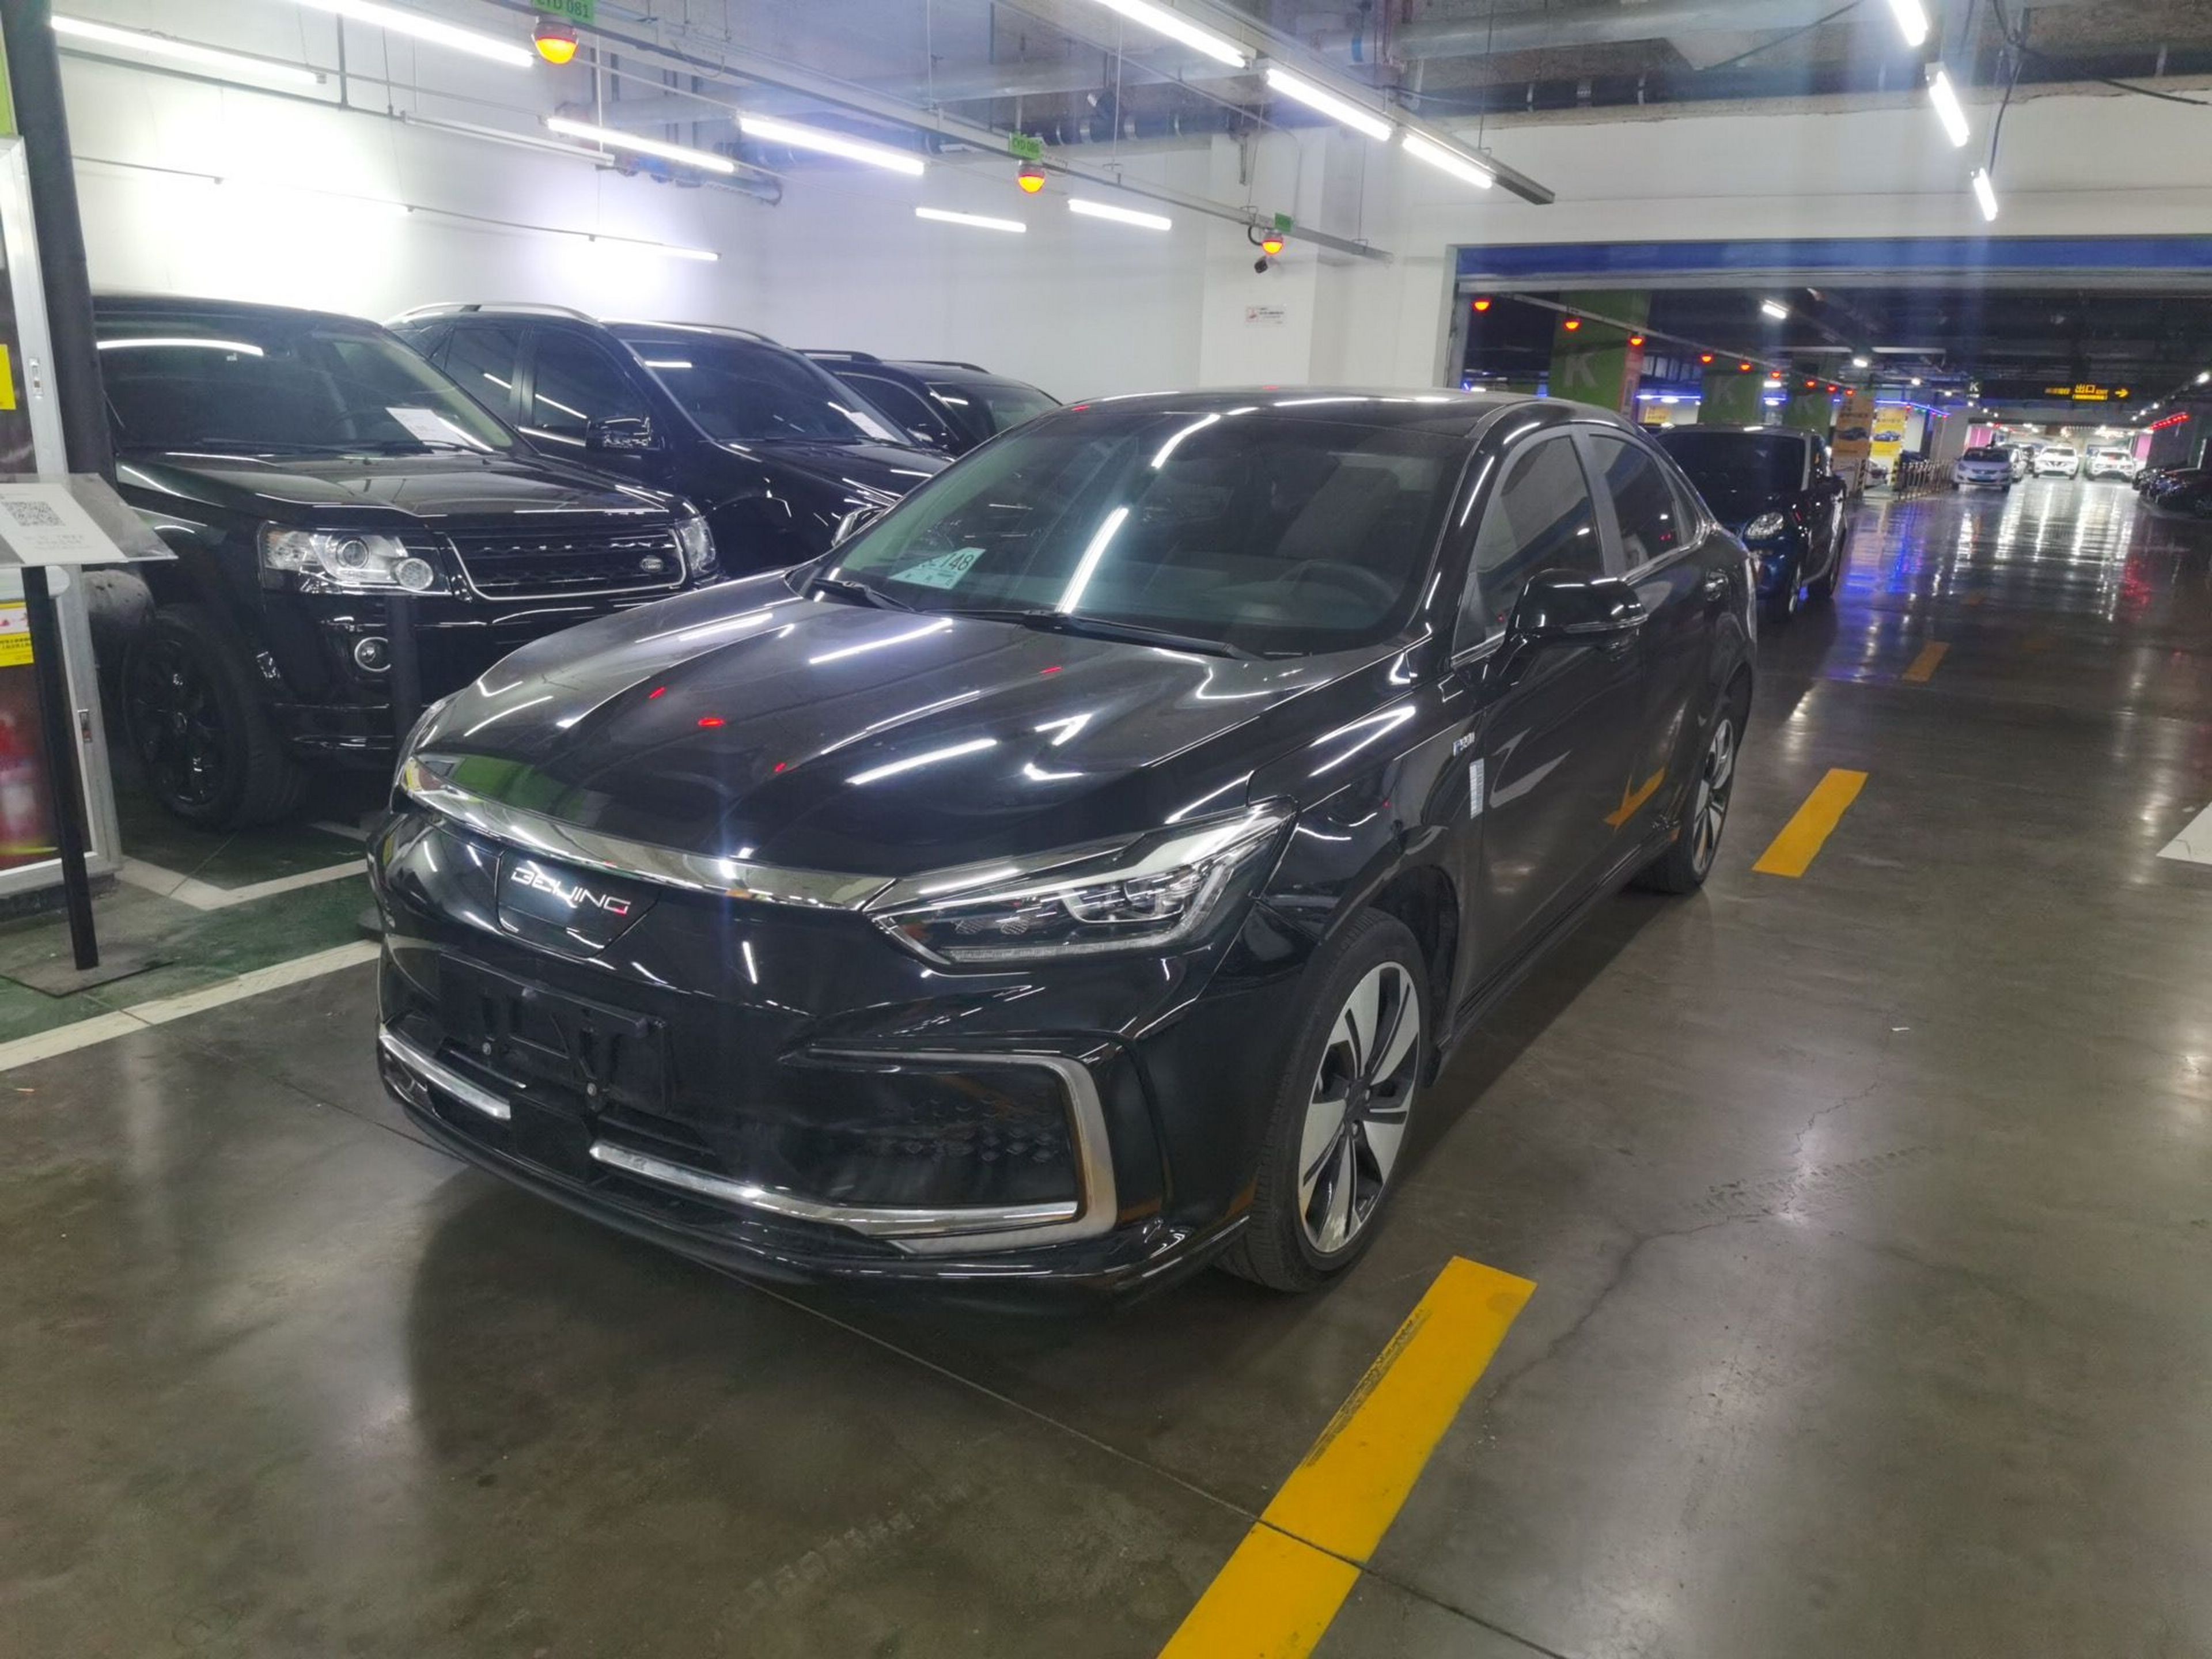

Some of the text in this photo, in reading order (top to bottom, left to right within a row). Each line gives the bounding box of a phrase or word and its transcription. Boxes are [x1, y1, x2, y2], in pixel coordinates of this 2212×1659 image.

[1563, 353, 1597, 387] K
[1969, 381, 1979, 392] K
[2074, 384, 2096, 394] 出口
[510, 867, 631, 915] BEIJING
